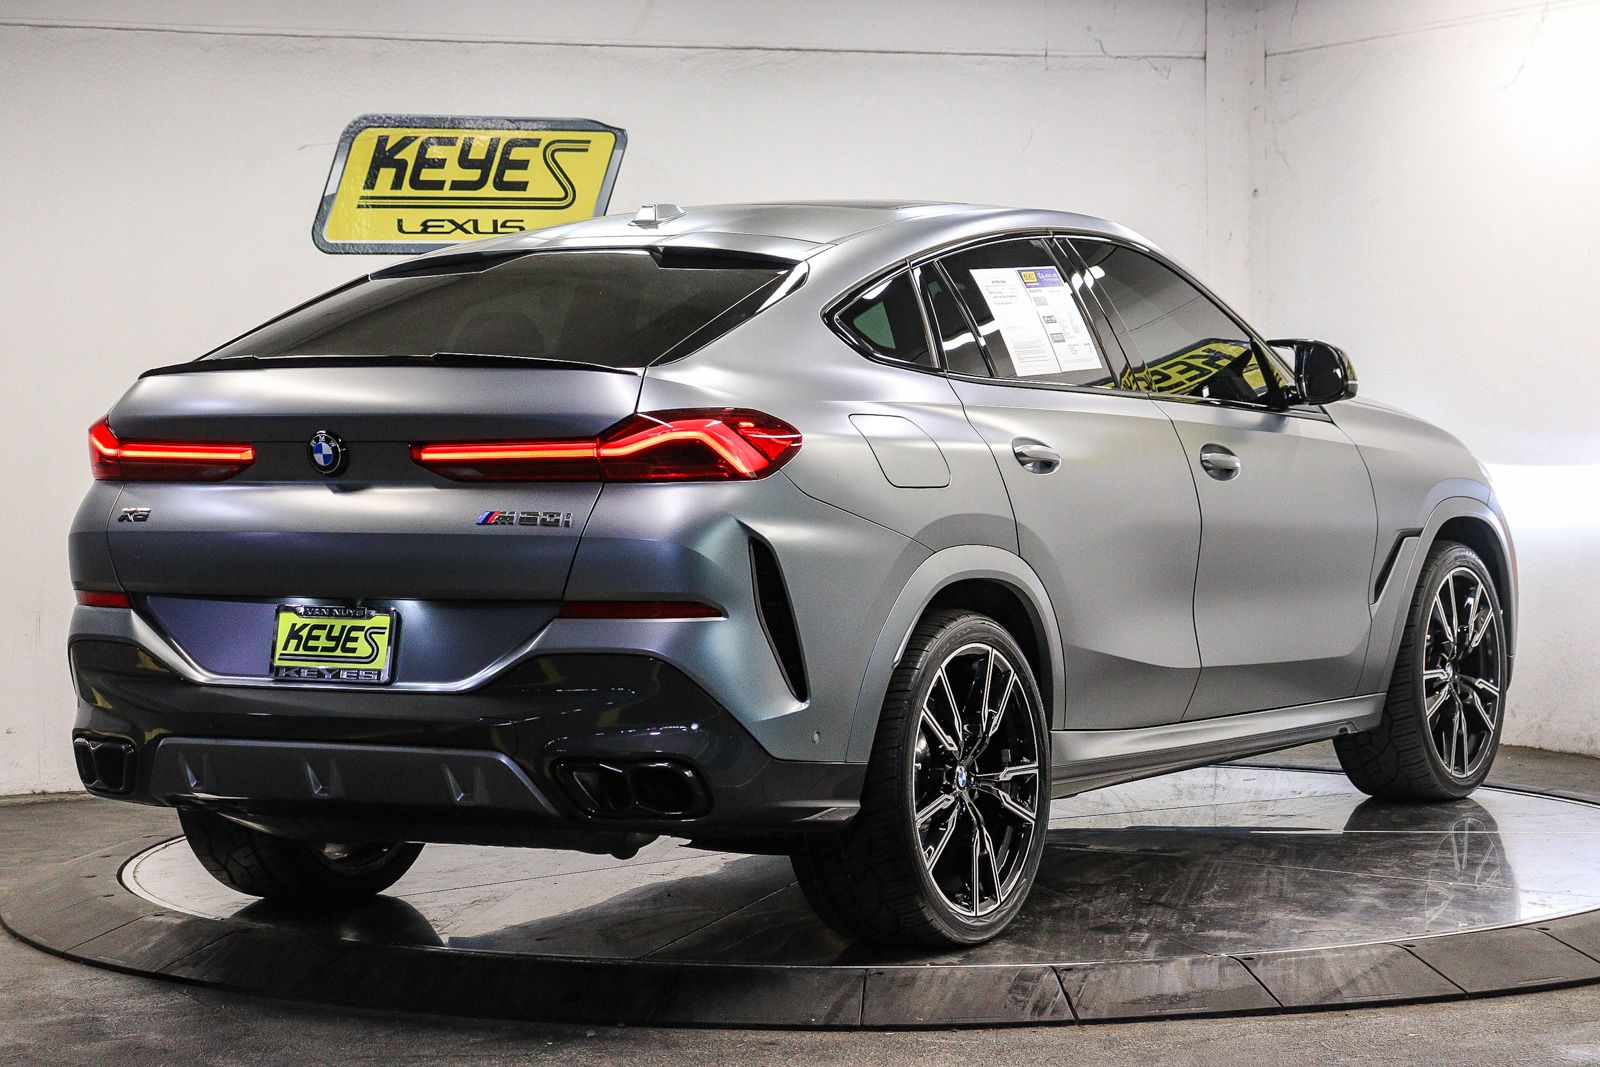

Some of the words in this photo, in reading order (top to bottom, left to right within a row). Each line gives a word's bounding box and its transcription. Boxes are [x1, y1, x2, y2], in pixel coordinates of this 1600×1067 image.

[357, 135, 591, 210] KEYES
[397, 218, 526, 235] LEXUS
[117, 508, 151, 522] X6
[306, 607, 330, 616] VAN
[278, 622, 388, 664] KEYES
[281, 667, 379, 679] KEYES
